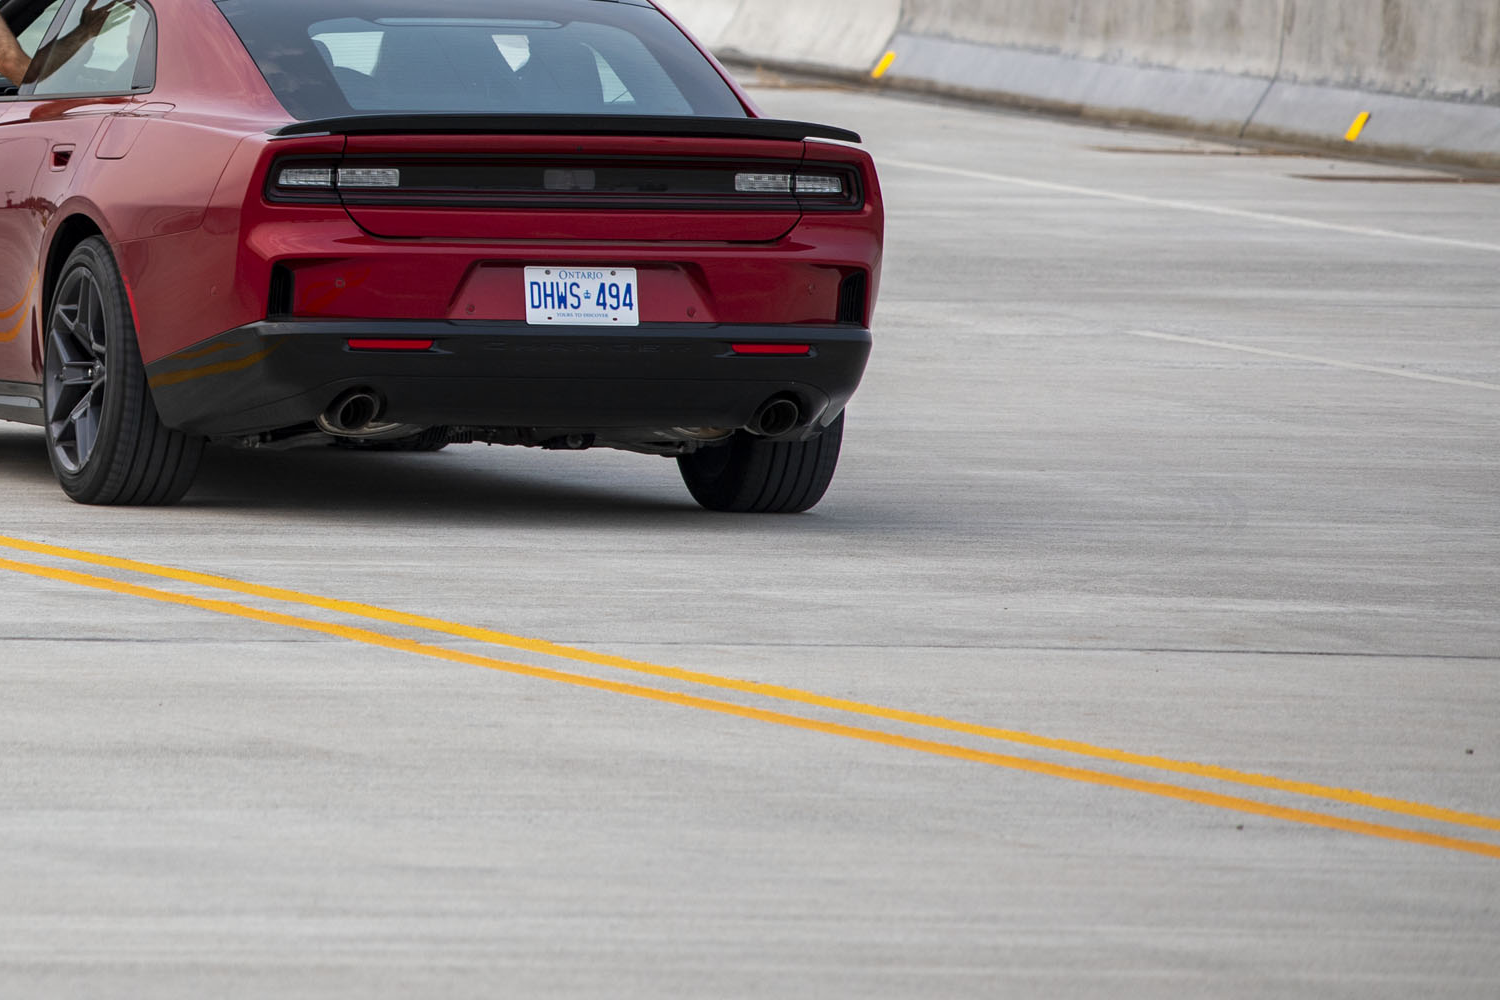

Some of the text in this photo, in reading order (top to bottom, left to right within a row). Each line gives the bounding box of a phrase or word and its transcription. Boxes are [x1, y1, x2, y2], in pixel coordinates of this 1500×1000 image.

[558, 269, 603, 281] ONTARIO
[530, 281, 634, 311] DHWS 494
